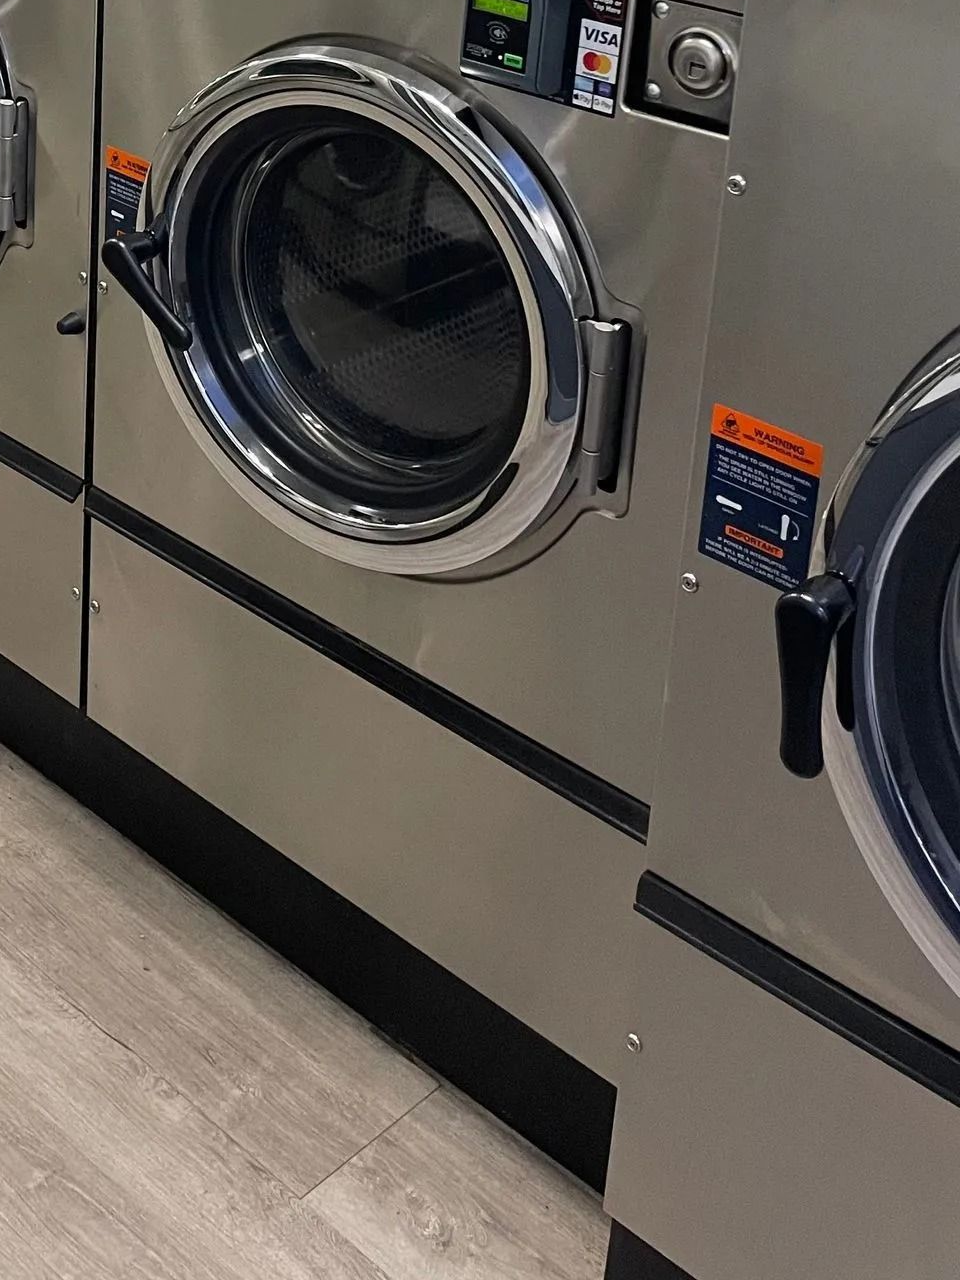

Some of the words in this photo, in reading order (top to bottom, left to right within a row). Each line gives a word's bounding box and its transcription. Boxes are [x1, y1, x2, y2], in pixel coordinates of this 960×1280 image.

[584, 26, 618, 48] VISA
[754, 428, 805, 456] WARNING
[719, 454, 730, 463] THE
[730, 458, 747, 470] DRUM
[754, 469, 770, 480] STILL
[770, 476, 796, 491] TURNING
[726, 448, 738, 456] NOT
[738, 452, 749, 460] TRY
[758, 461, 774, 472] OPEN
[776, 468, 792, 480] DOOR
[718, 460, 730, 470] YOU
[730, 465, 741, 474] SEE
[742, 469, 762, 483] WATER
[770, 482, 781, 491] THE
[782, 486, 807, 502] WINDOW
[730, 470, 748, 483] CYCLE
[748, 478, 765, 490] LIGHT
[772, 489, 788, 500] STILL
[724, 538, 743, 550] POWER
[728, 528, 782, 556] IMPORTANT
[705, 544, 726, 558] BEFORE
[727, 554, 738, 564] THE
[738, 560, 754, 571] DOOR
[754, 567, 766, 576] CAN
[766, 572, 774, 580] BE
[706, 538, 722, 550] THERE
[724, 546, 736, 556] WILL
[737, 552, 744, 560] BE
[760, 562, 780, 577] MINUTE
[781, 572, 800, 584] DELAY
